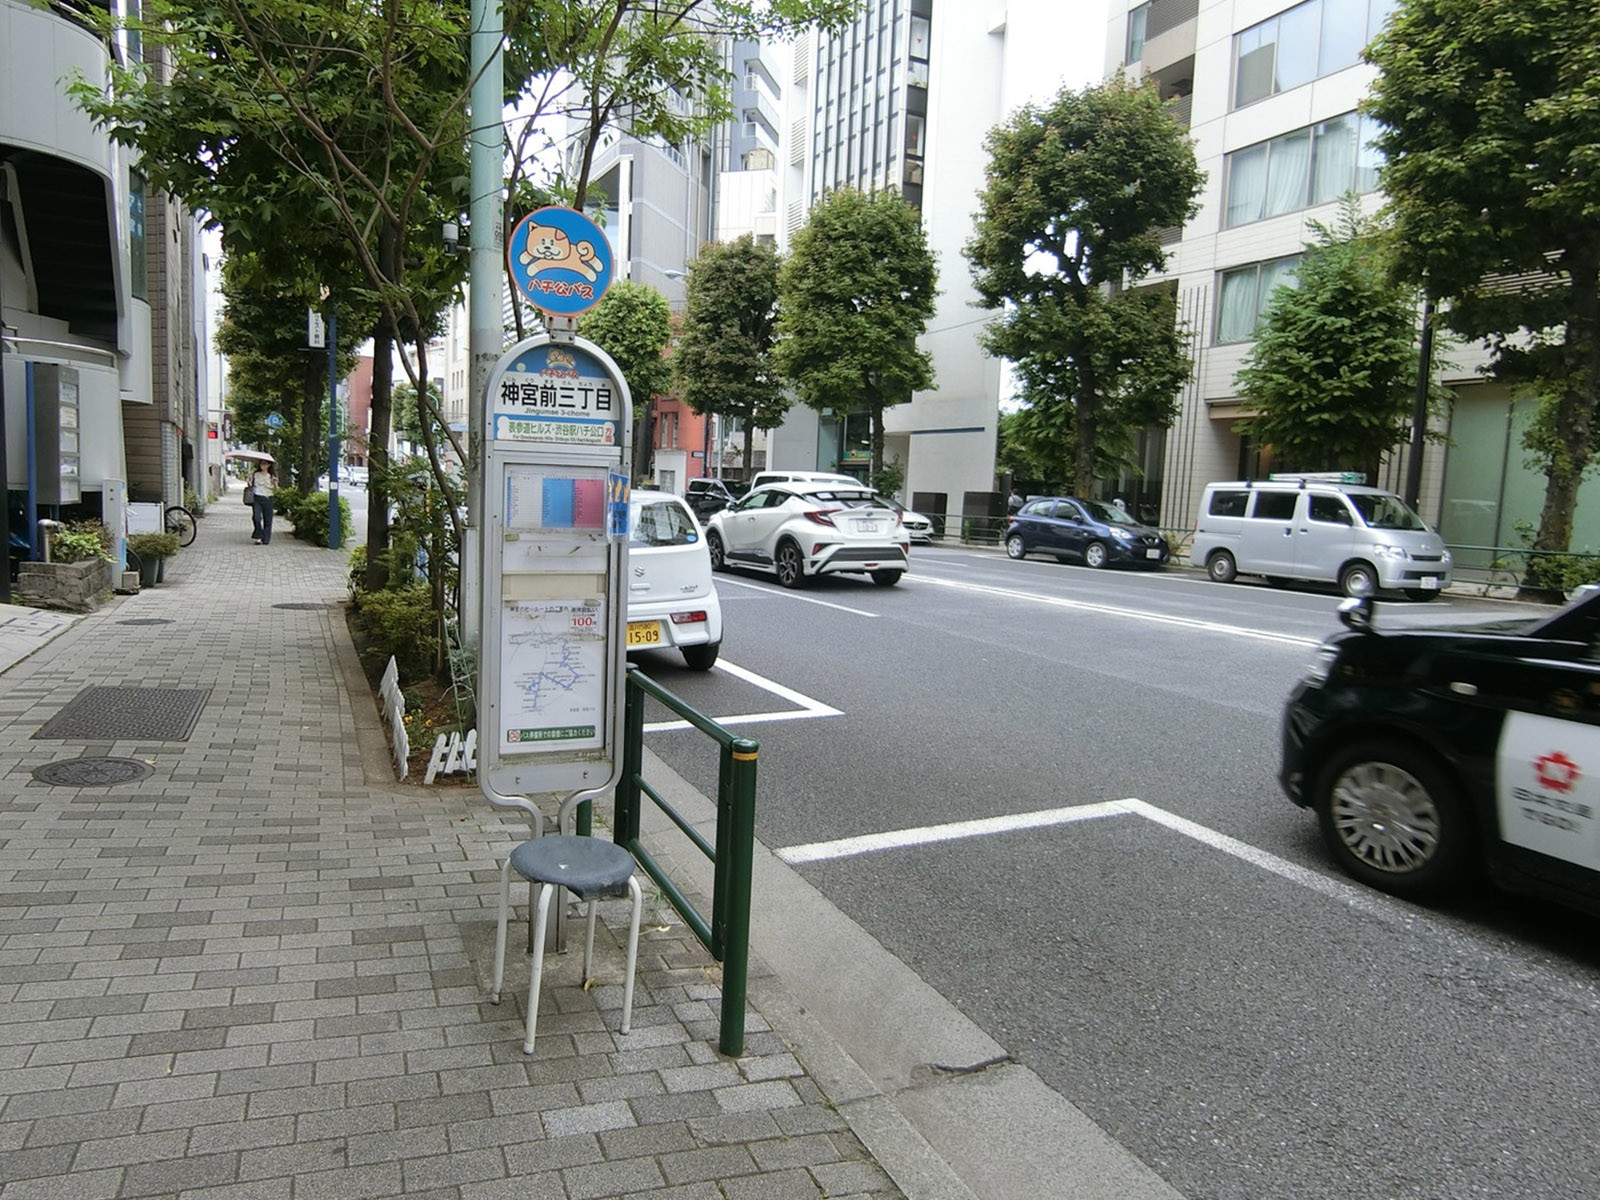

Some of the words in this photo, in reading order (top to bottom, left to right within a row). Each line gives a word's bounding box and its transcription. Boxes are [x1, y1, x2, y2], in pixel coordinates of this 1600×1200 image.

[528, 279, 594, 299] ハチ公バス
[501, 381, 612, 411] 神宮前三丁目
[524, 407, 559, 416] Jingumae
[560, 410, 591, 418] 3-chome
